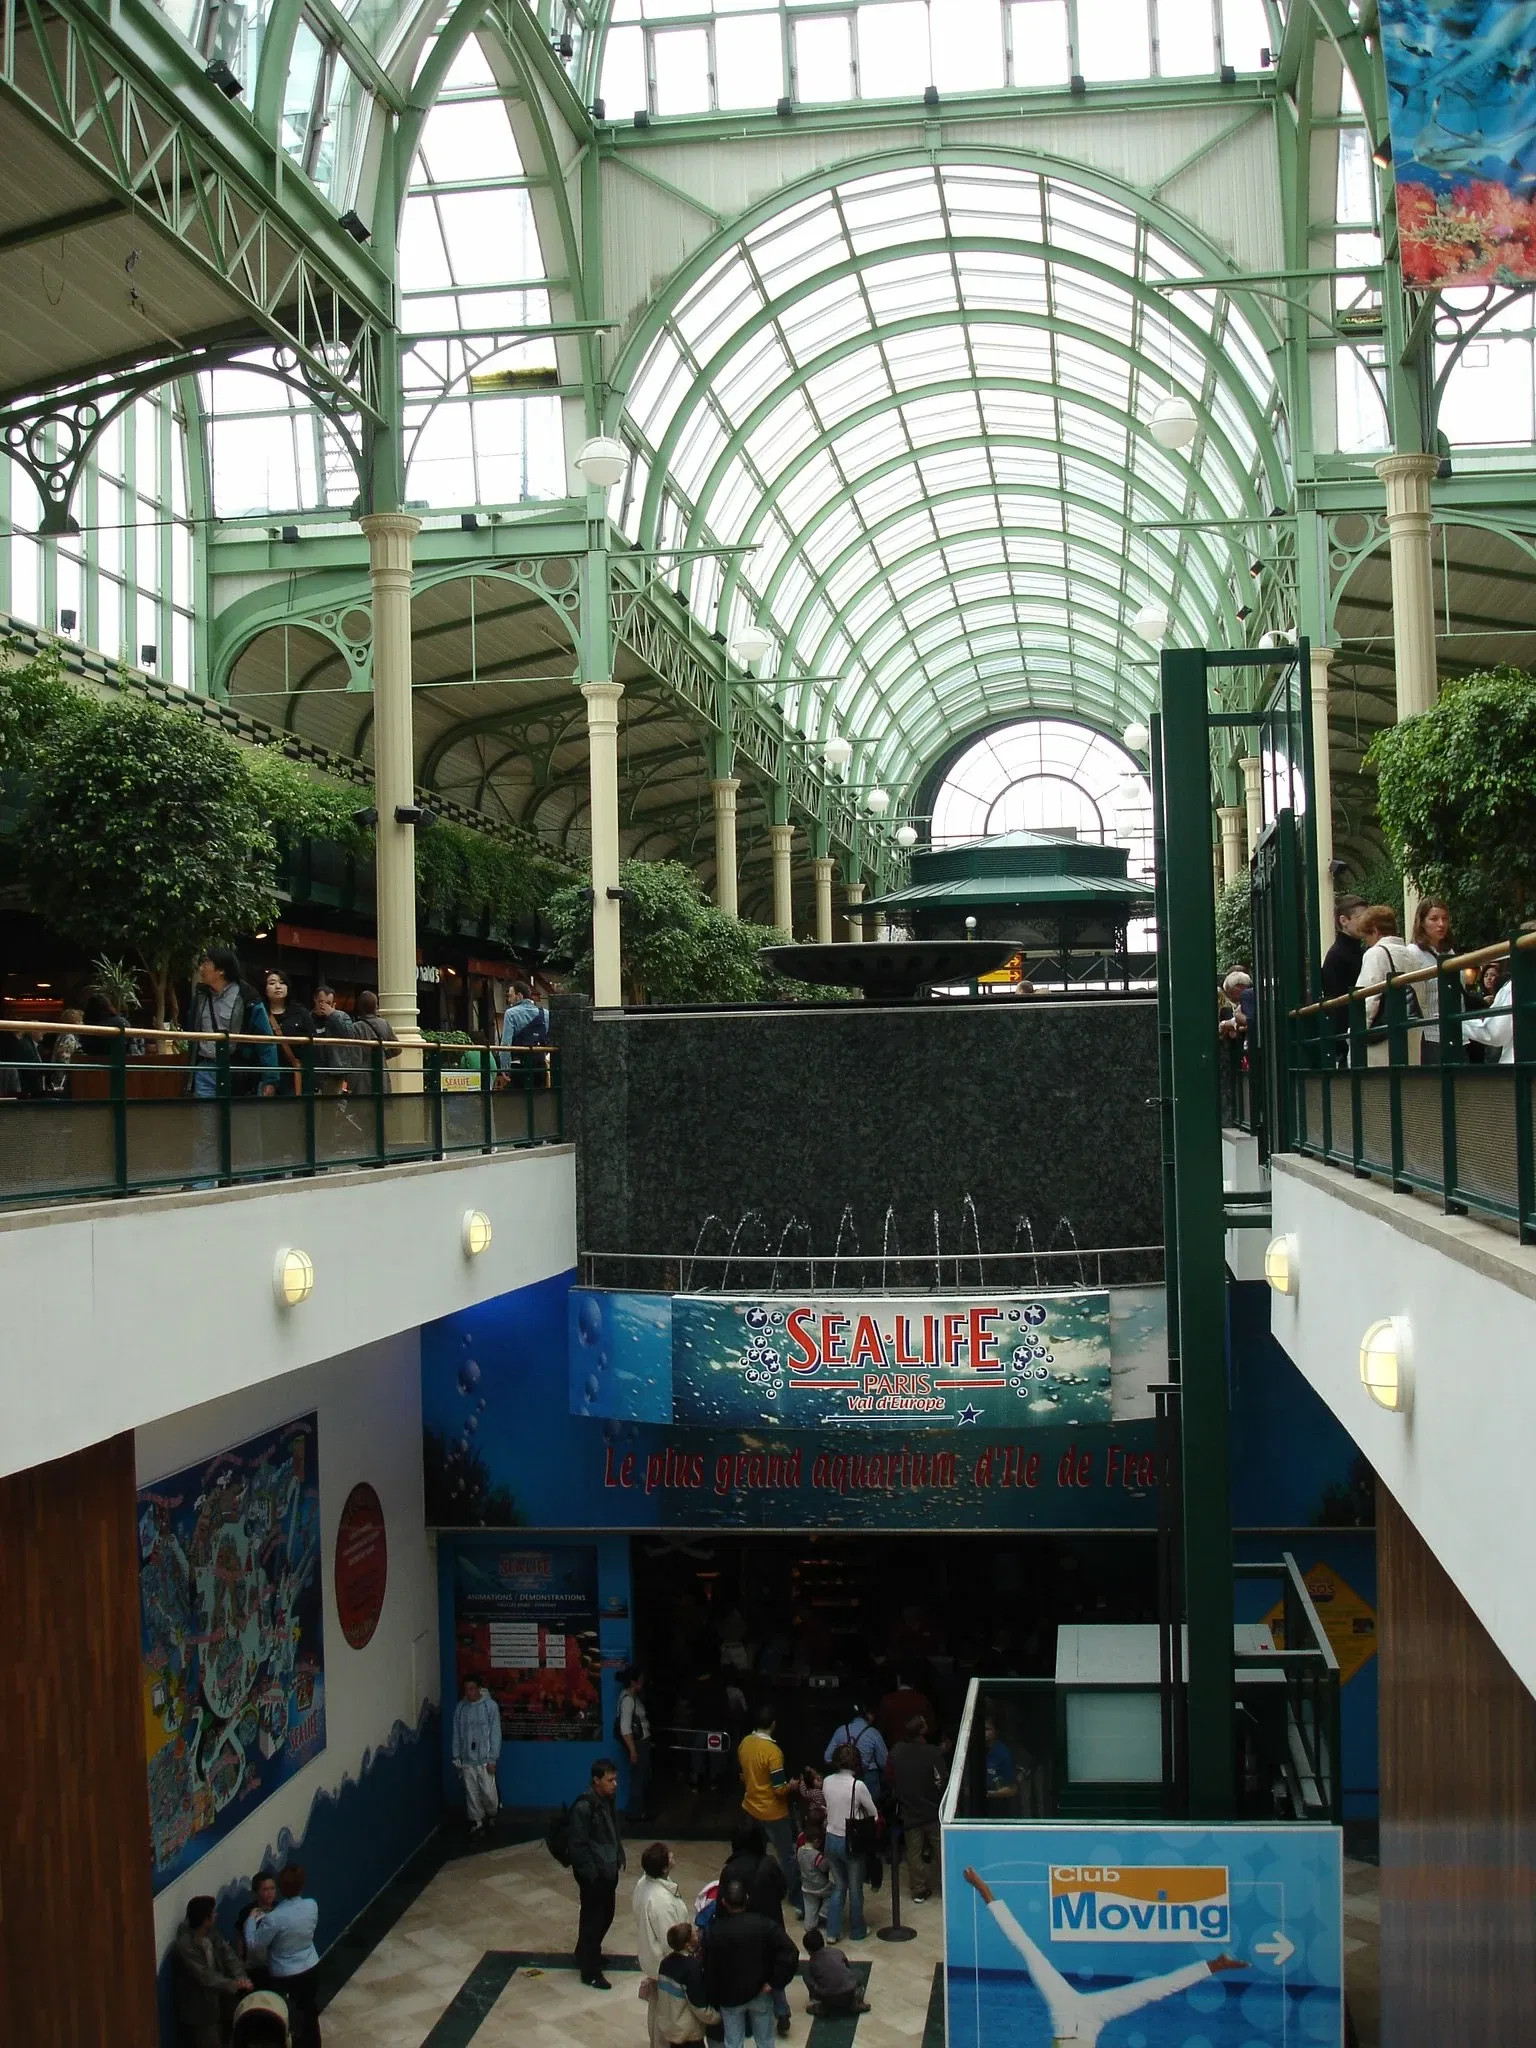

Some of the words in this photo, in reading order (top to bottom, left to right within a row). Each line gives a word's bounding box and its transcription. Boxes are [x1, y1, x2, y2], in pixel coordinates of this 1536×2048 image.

[863, 1373, 932, 1395] PARIS
[847, 1395, 874, 1411] Val
[876, 1395, 945, 1412] d'Europe
[603, 1446, 637, 1488] Le
[645, 1446, 705, 1496] plus
[713, 1446, 804, 1497] grand
[812, 1443, 957, 1496] aquarium
[973, 1443, 1041, 1489] d'Ile
[1056, 1443, 1094, 1488] de
[1053, 1866, 1121, 1882] Club
[1051, 1889, 1228, 1938] Moving
